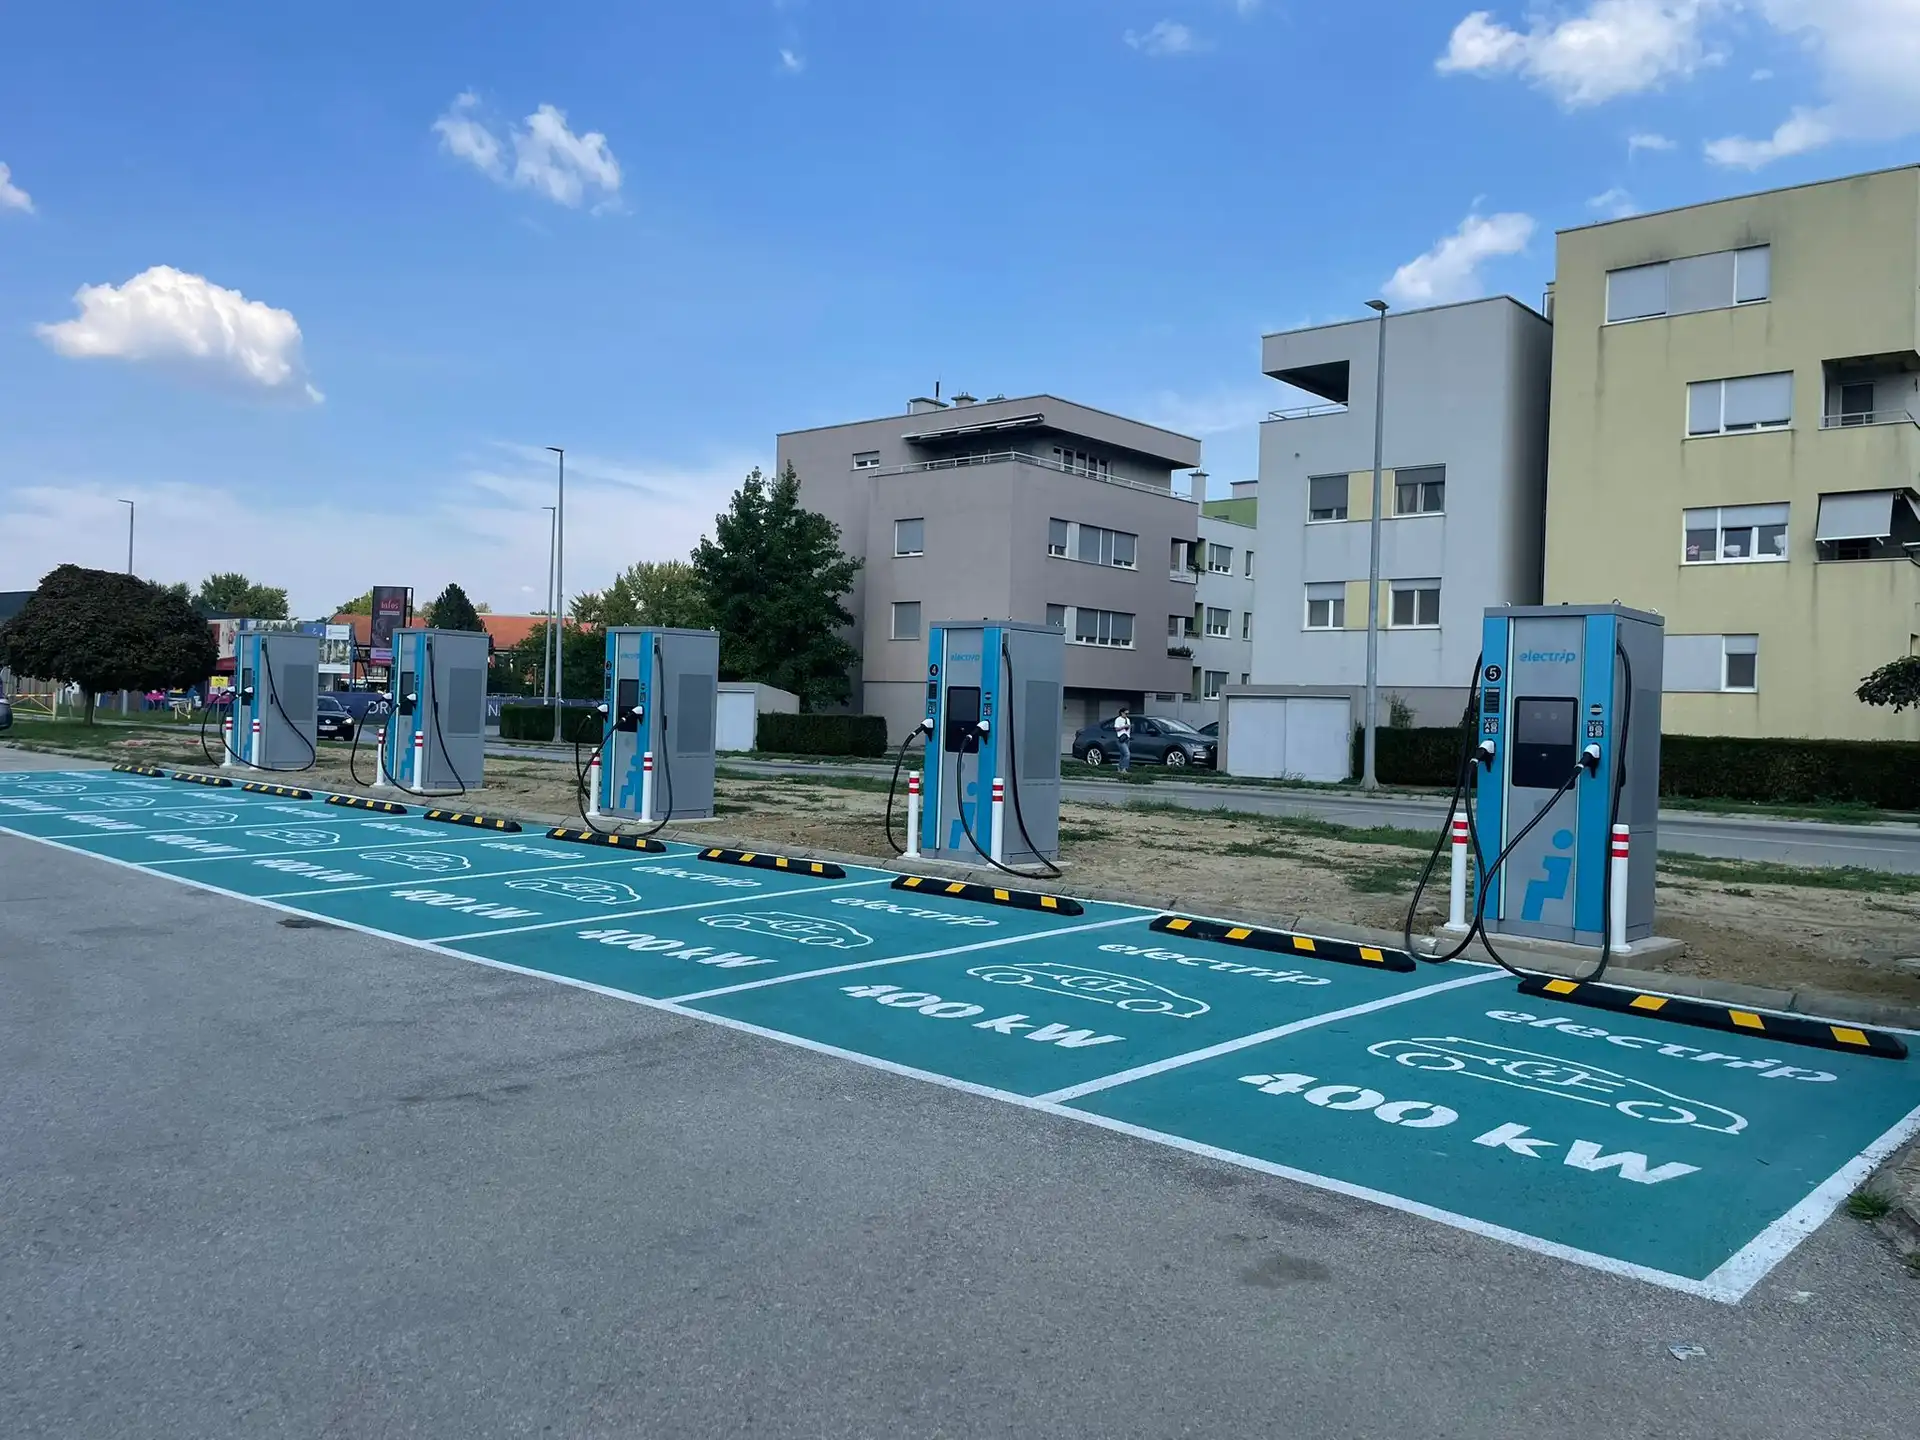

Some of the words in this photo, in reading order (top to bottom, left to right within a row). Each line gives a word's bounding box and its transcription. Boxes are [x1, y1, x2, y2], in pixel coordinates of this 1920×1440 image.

[1519, 649, 1576, 664] electrip
[389, 889, 478, 906] 400
[450, 902, 544, 920] kW
[830, 897, 1000, 926] electrip
[576, 929, 686, 951] 400
[661, 946, 779, 968] kW
[1097, 943, 1332, 986] electrip
[838, 984, 985, 1018] 400
[971, 1013, 1127, 1048] kW
[1484, 1009, 1838, 1083] electrip
[1237, 1072, 1459, 1128] 400
[1471, 1121, 1702, 1185] kW
